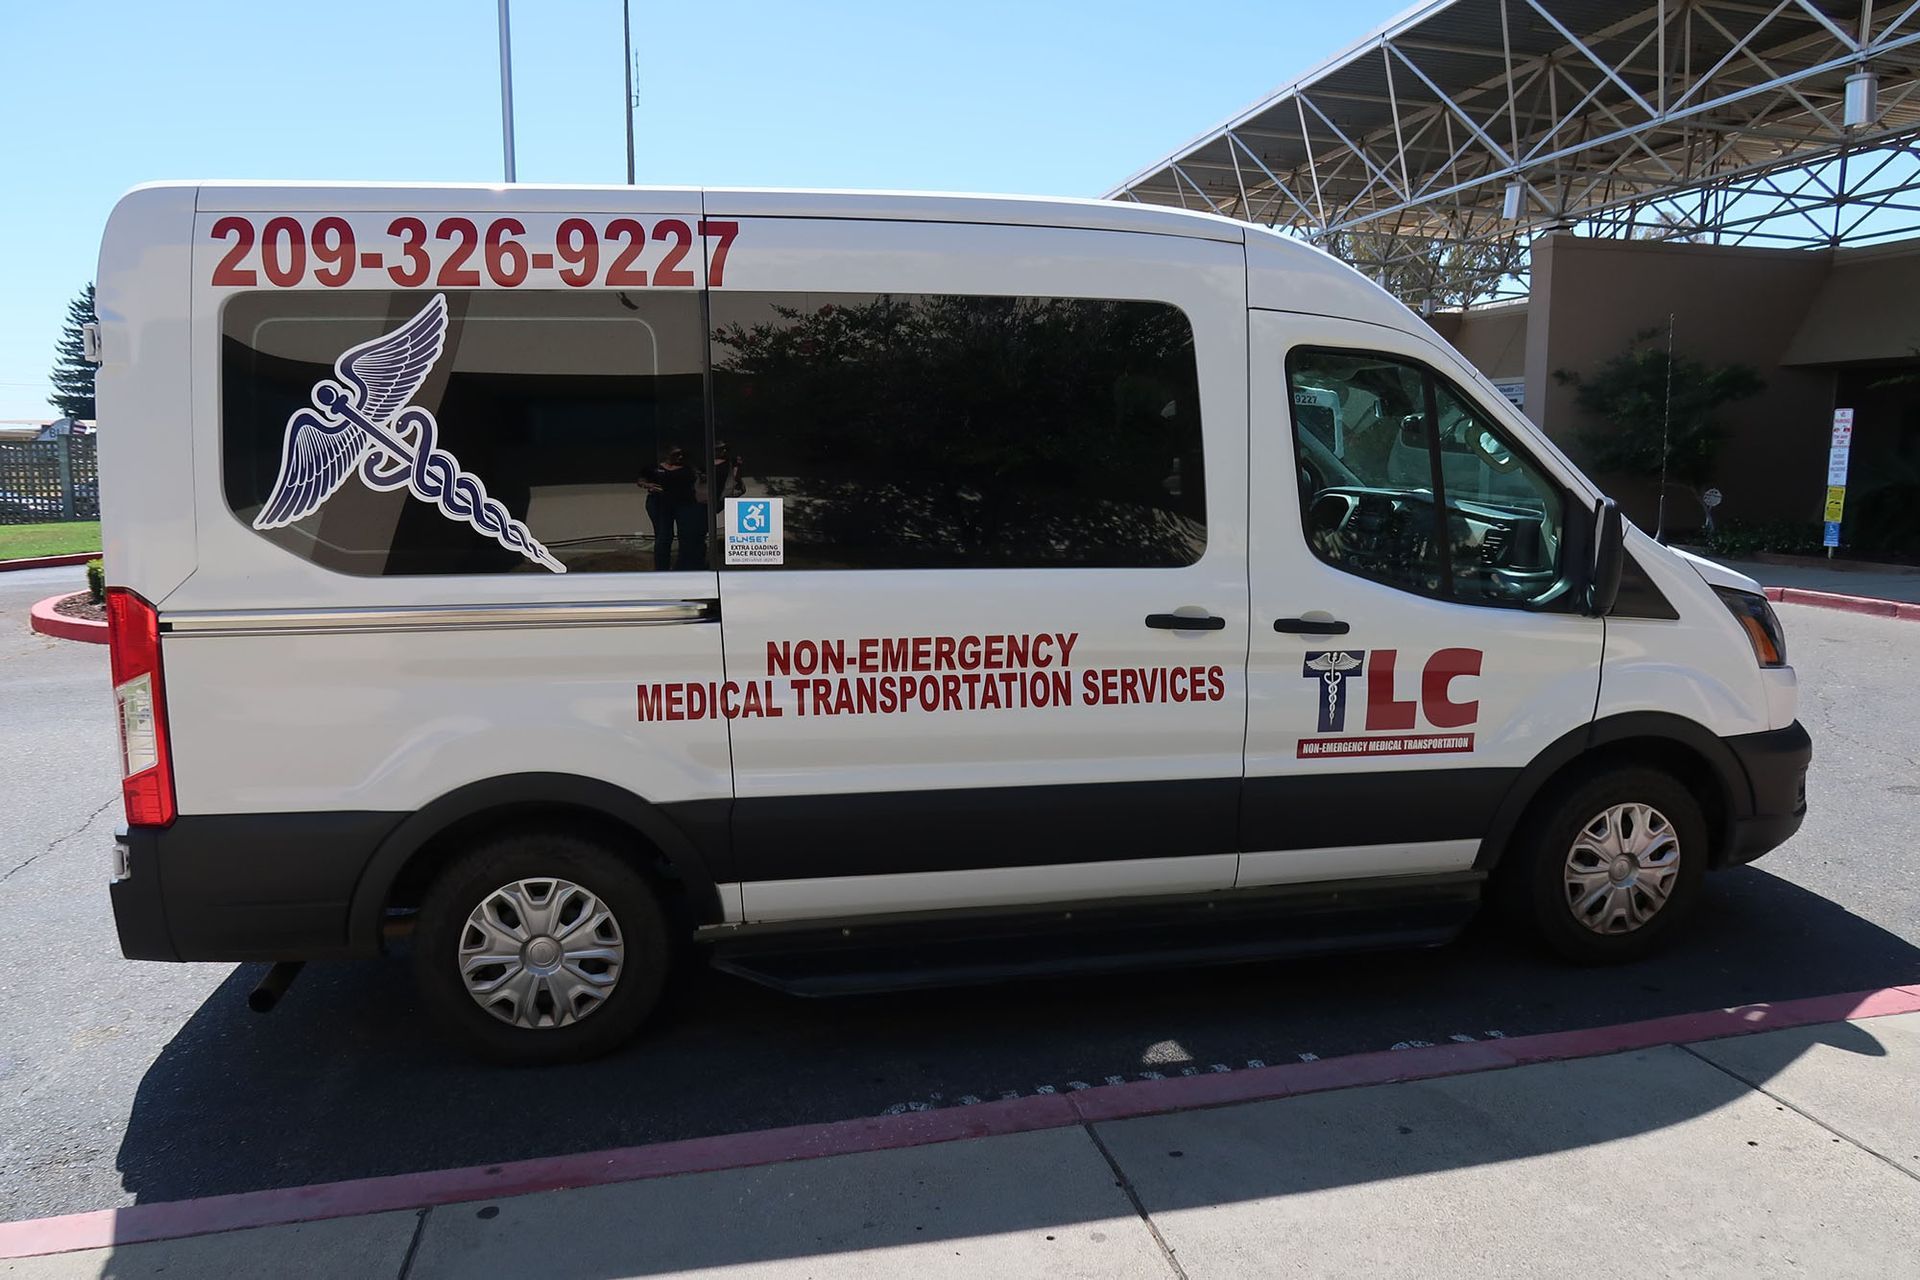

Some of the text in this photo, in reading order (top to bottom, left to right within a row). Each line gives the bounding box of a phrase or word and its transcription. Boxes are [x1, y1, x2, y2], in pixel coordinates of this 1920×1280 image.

[210, 216, 740, 288] 209-326-9227
[1296, 394, 1317, 404] 9227
[766, 632, 1079, 677] NON-EMERGENCY
[636, 665, 1225, 722] MEDICAL TRANSPORTATION SERVICES
[1303, 647, 1483, 732] TLC
[1302, 737, 1470, 754] NON-EMERGENCY MEDICAL TRANSPORTATION
